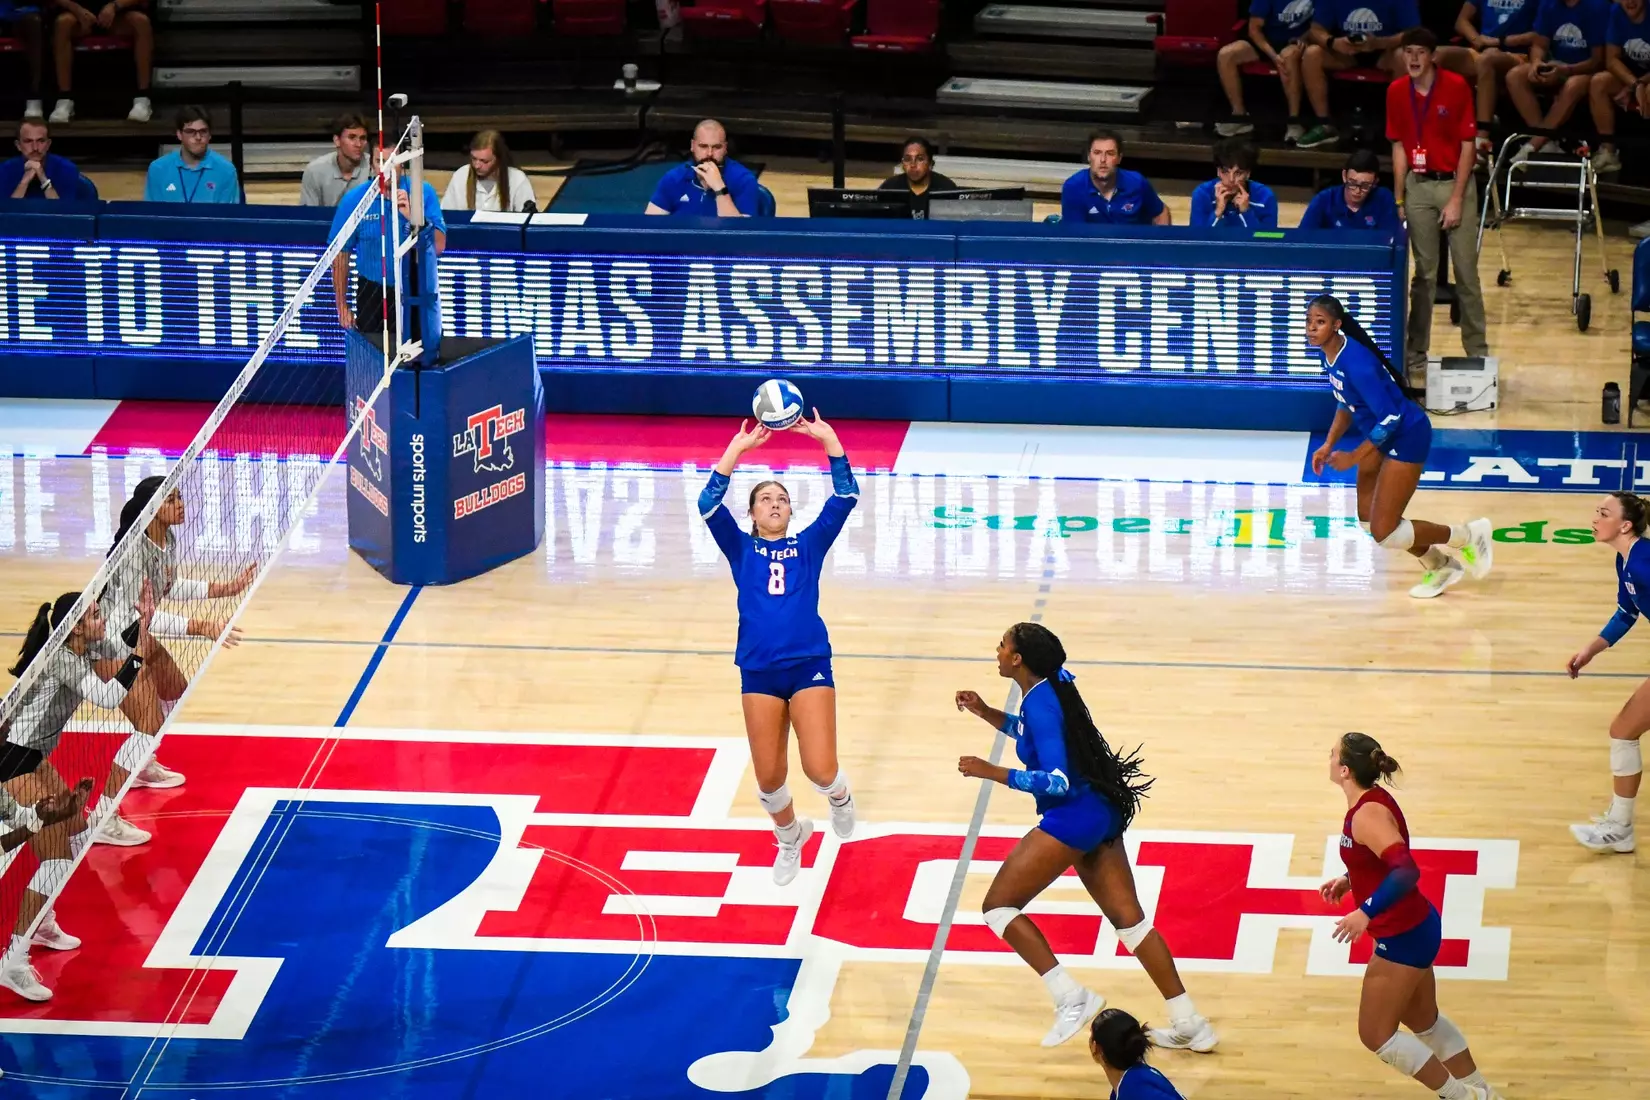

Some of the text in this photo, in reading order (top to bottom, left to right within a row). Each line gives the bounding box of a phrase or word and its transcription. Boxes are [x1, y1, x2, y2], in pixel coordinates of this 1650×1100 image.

[73, 246, 163, 346] TO
[186, 249, 320, 348] THE
[438, 257, 654, 361] OMAS
[680, 263, 1072, 367] ASSEMBLY
[409, 434, 428, 543] sports imports
[454, 472, 525, 520] BULLDOGS
[754, 544, 798, 561] LA TECH
[768, 562, 786, 595] 8
